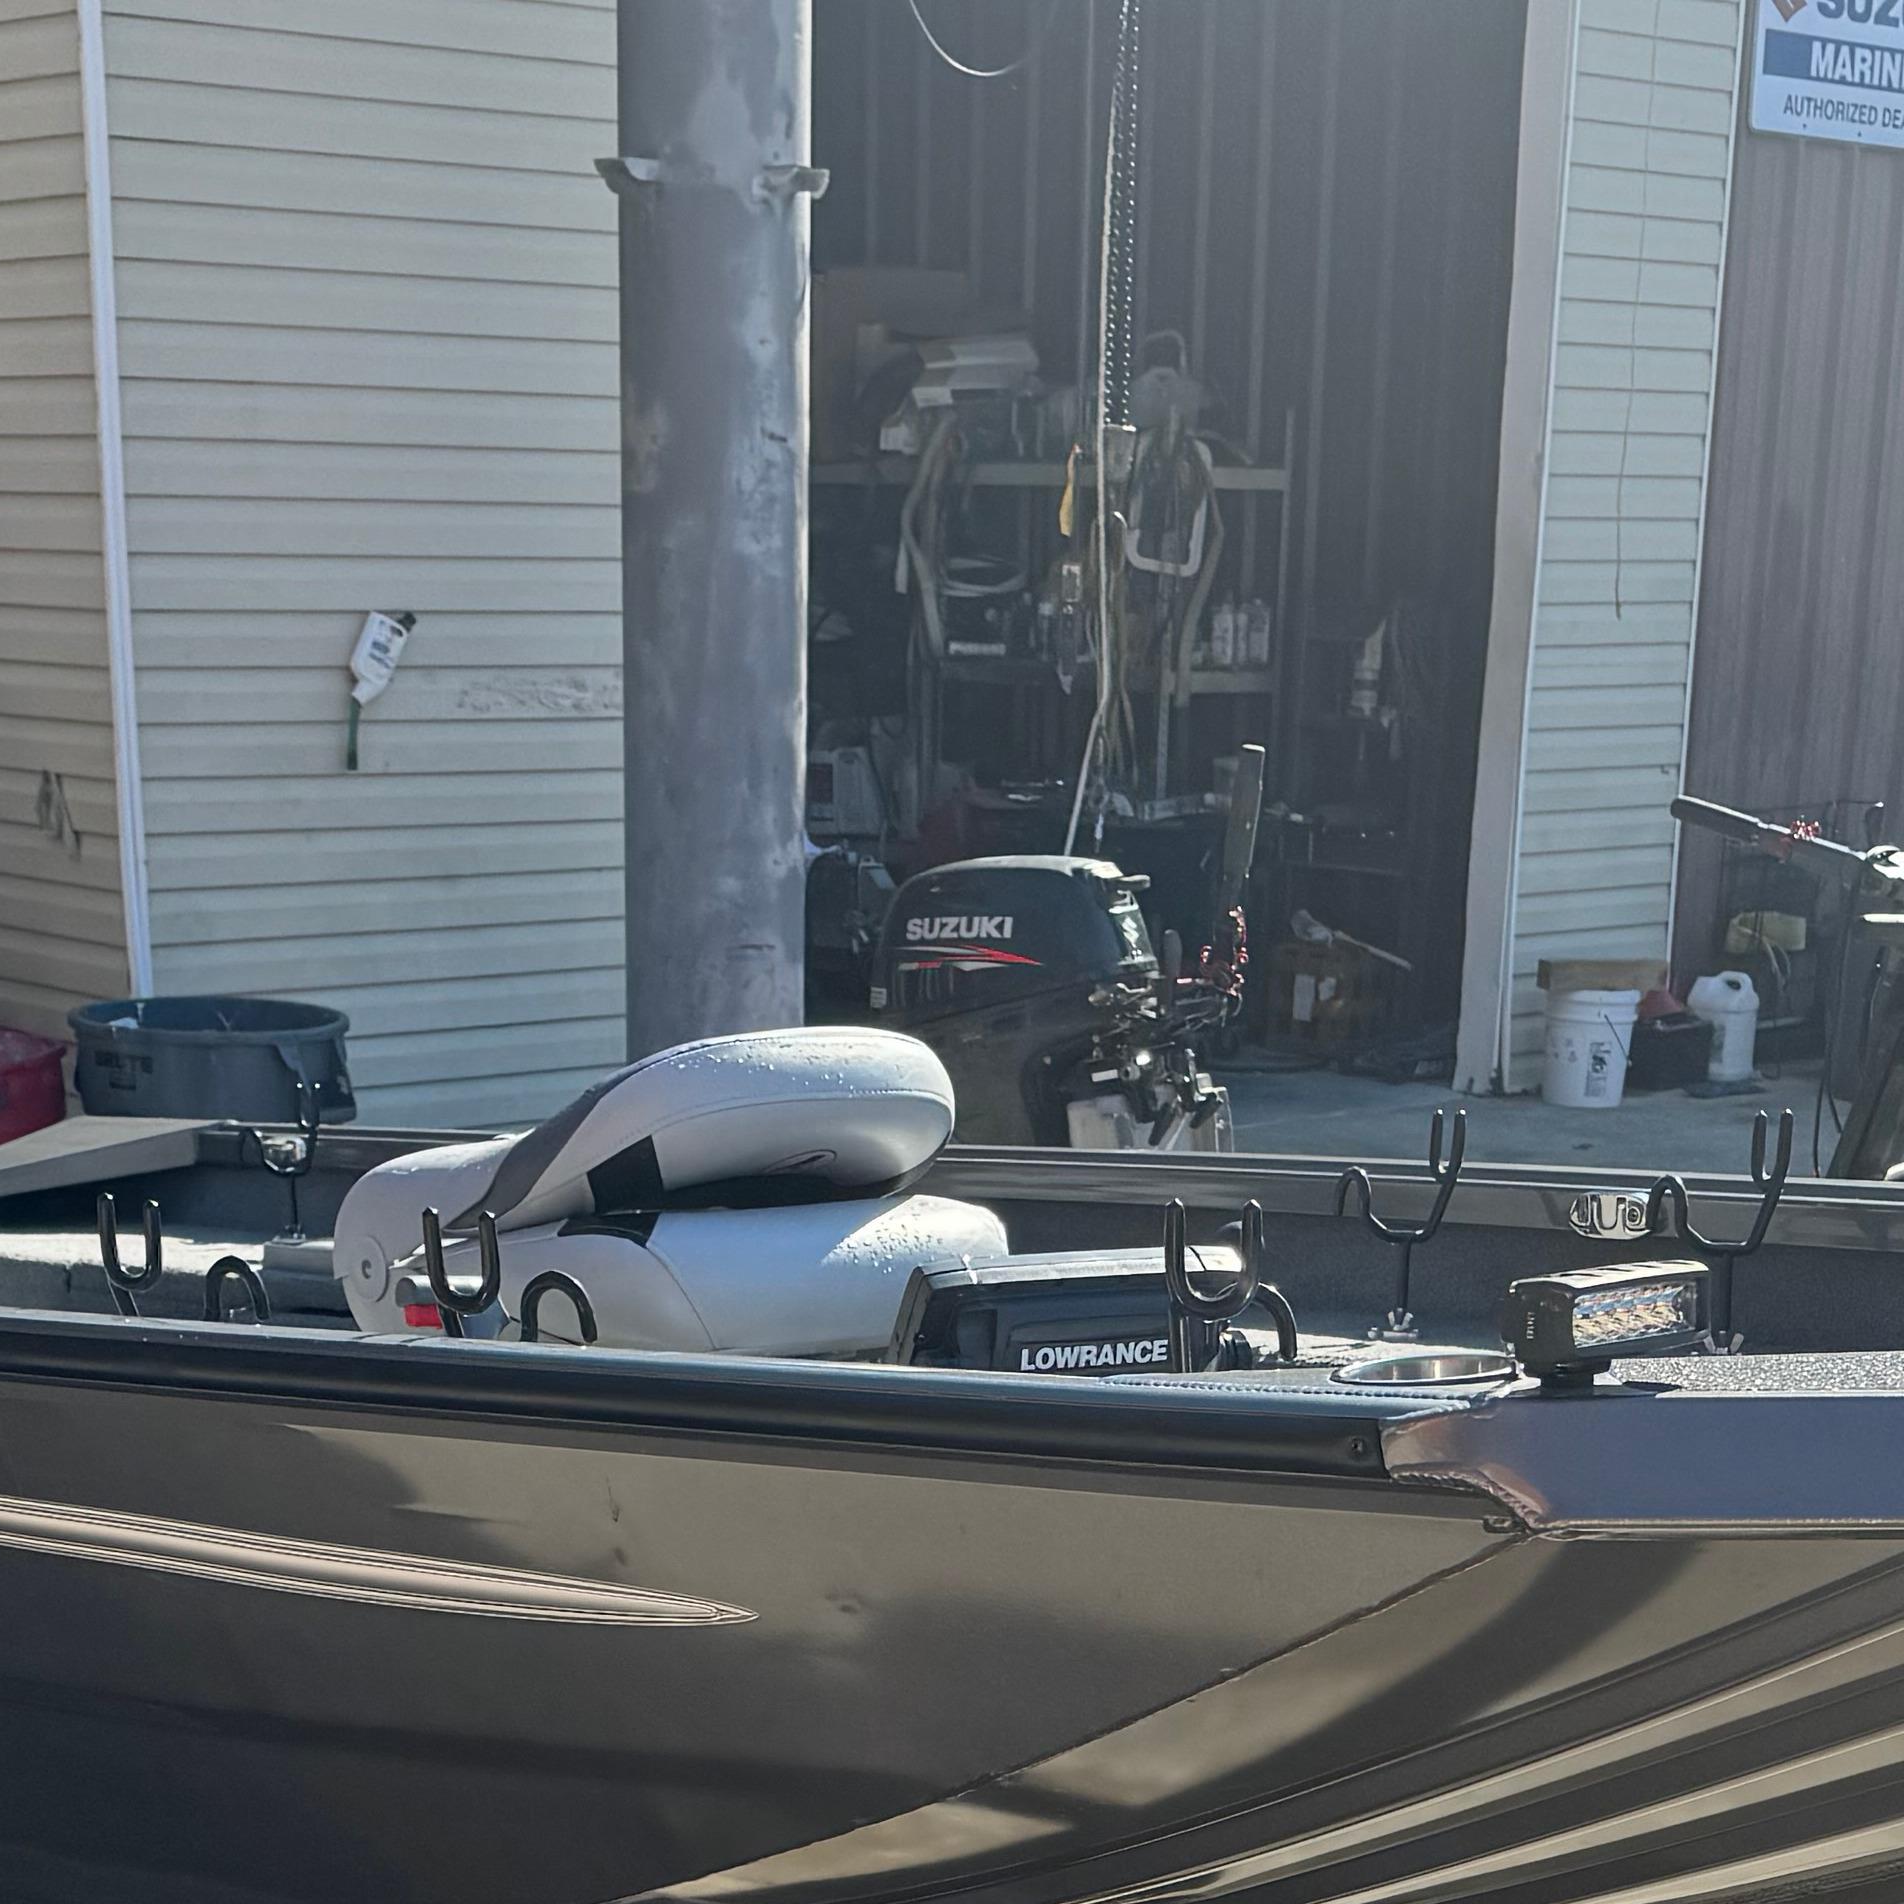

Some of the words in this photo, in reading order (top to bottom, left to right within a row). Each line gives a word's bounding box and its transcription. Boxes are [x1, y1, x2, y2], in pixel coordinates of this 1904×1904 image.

[1784, 94, 1878, 126] AUTHORIZED
[906, 916, 1013, 941] SUZUKI
[1020, 1339, 1169, 1373] LOWRANCE
